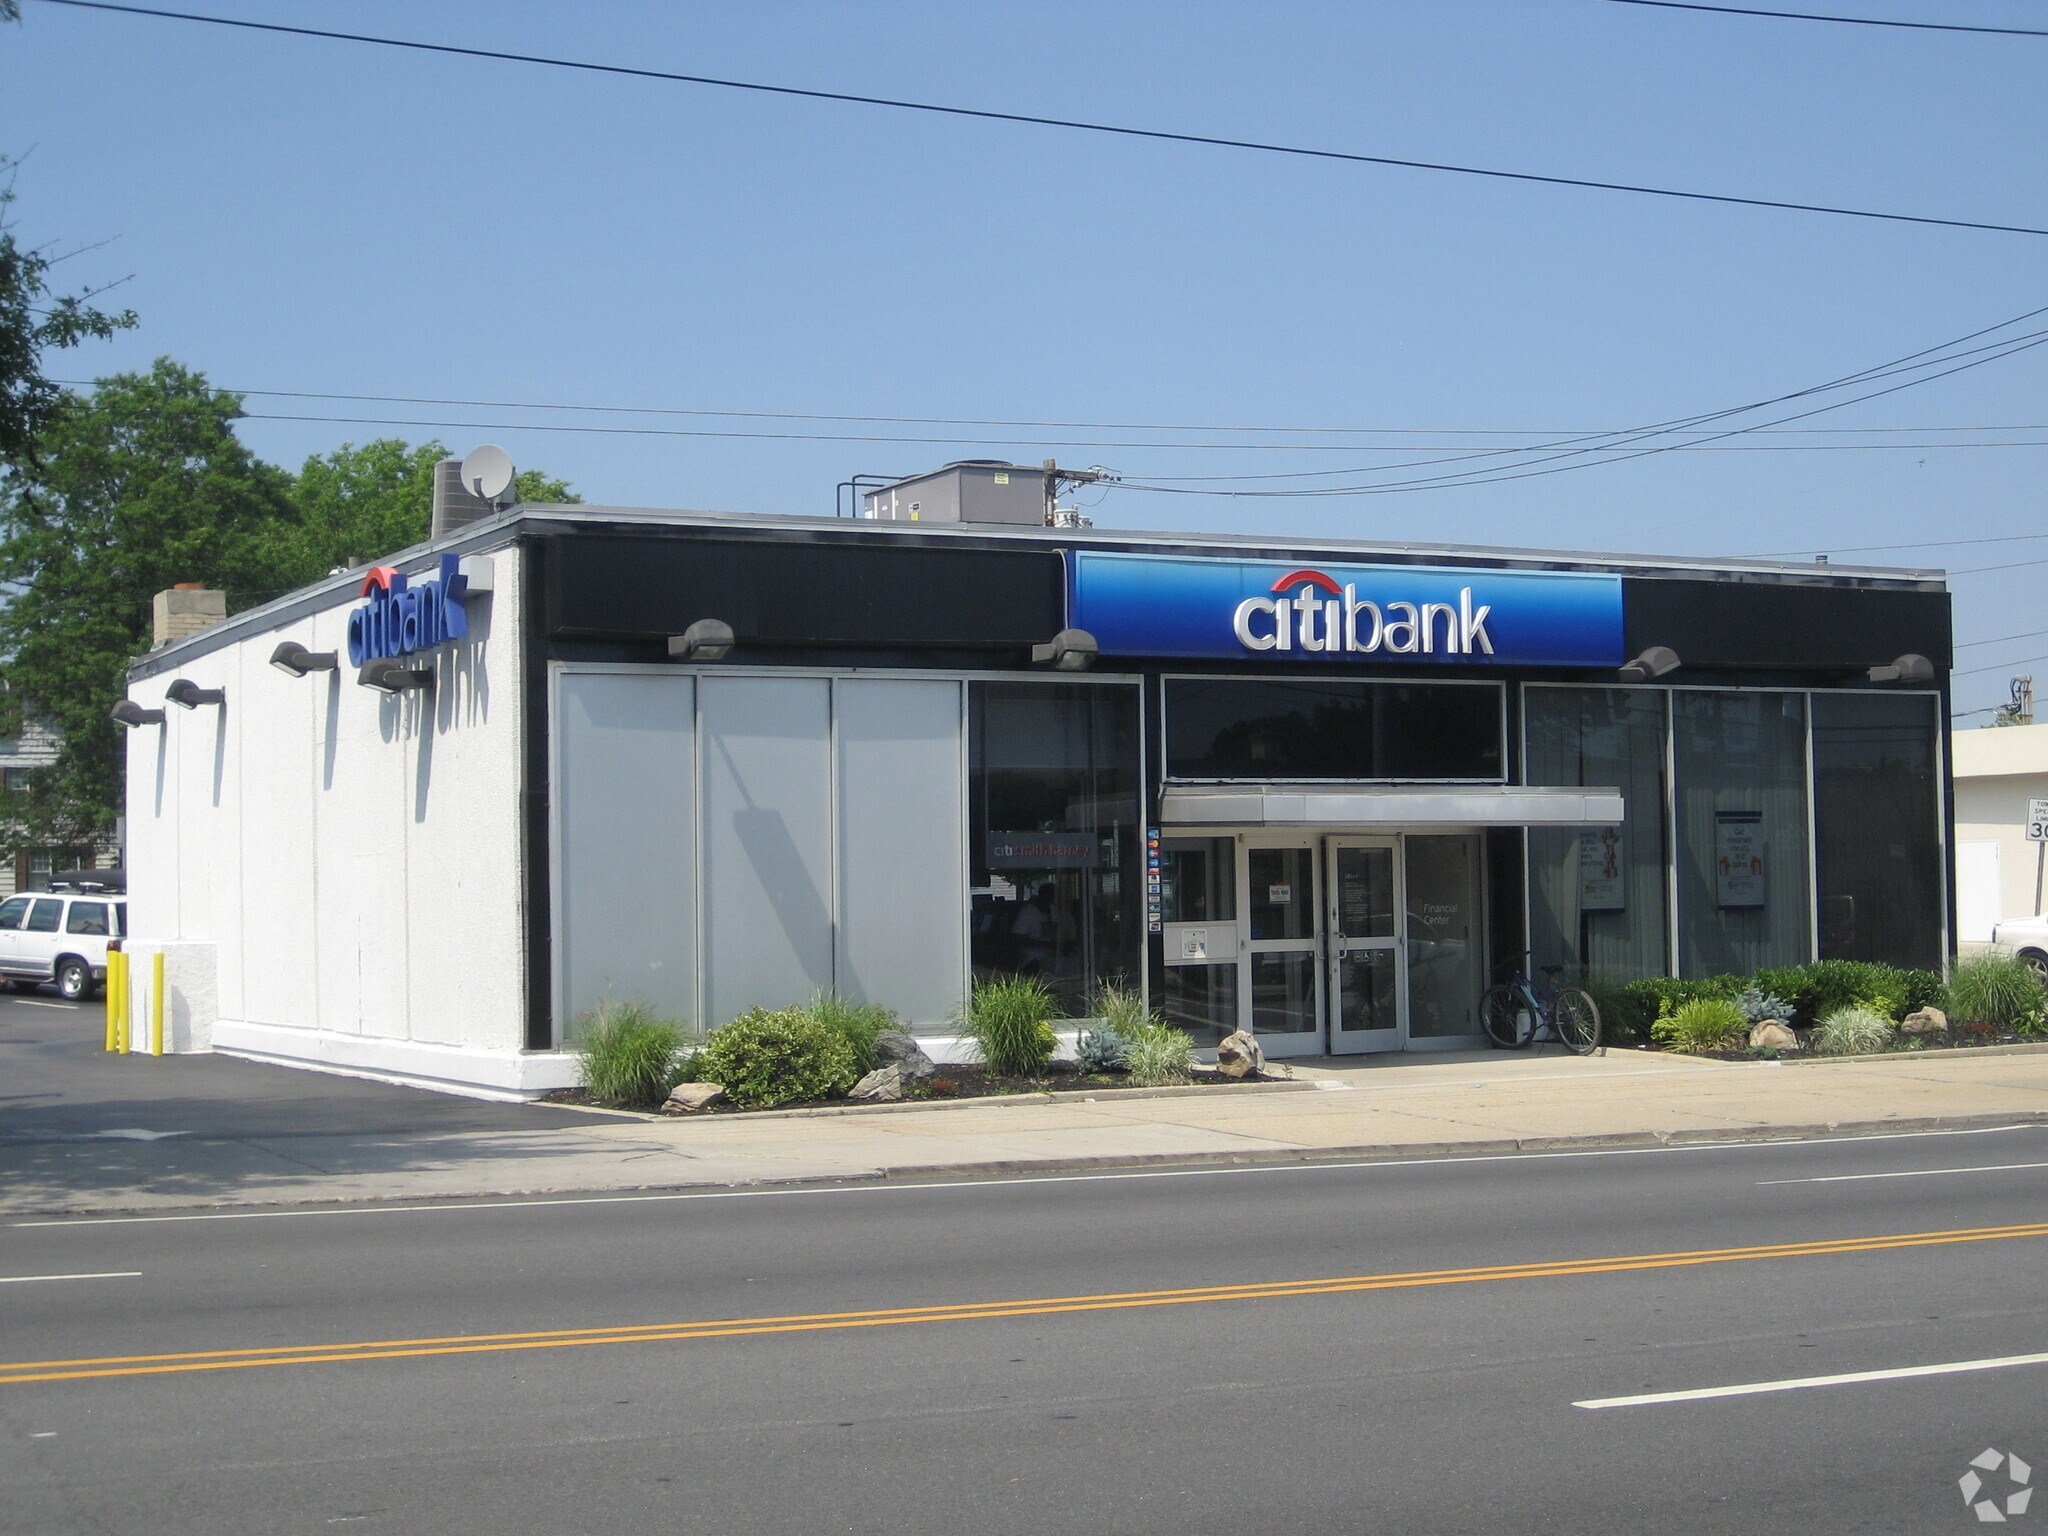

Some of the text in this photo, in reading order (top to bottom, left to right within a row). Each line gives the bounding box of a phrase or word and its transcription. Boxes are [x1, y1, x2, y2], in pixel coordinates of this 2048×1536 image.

[347, 553, 468, 669] citibank
[1233, 582, 1494, 654] citibank
[994, 843, 1013, 857] citi
[1423, 903, 1458, 913] Financial
[1423, 915, 1450, 925] Center
